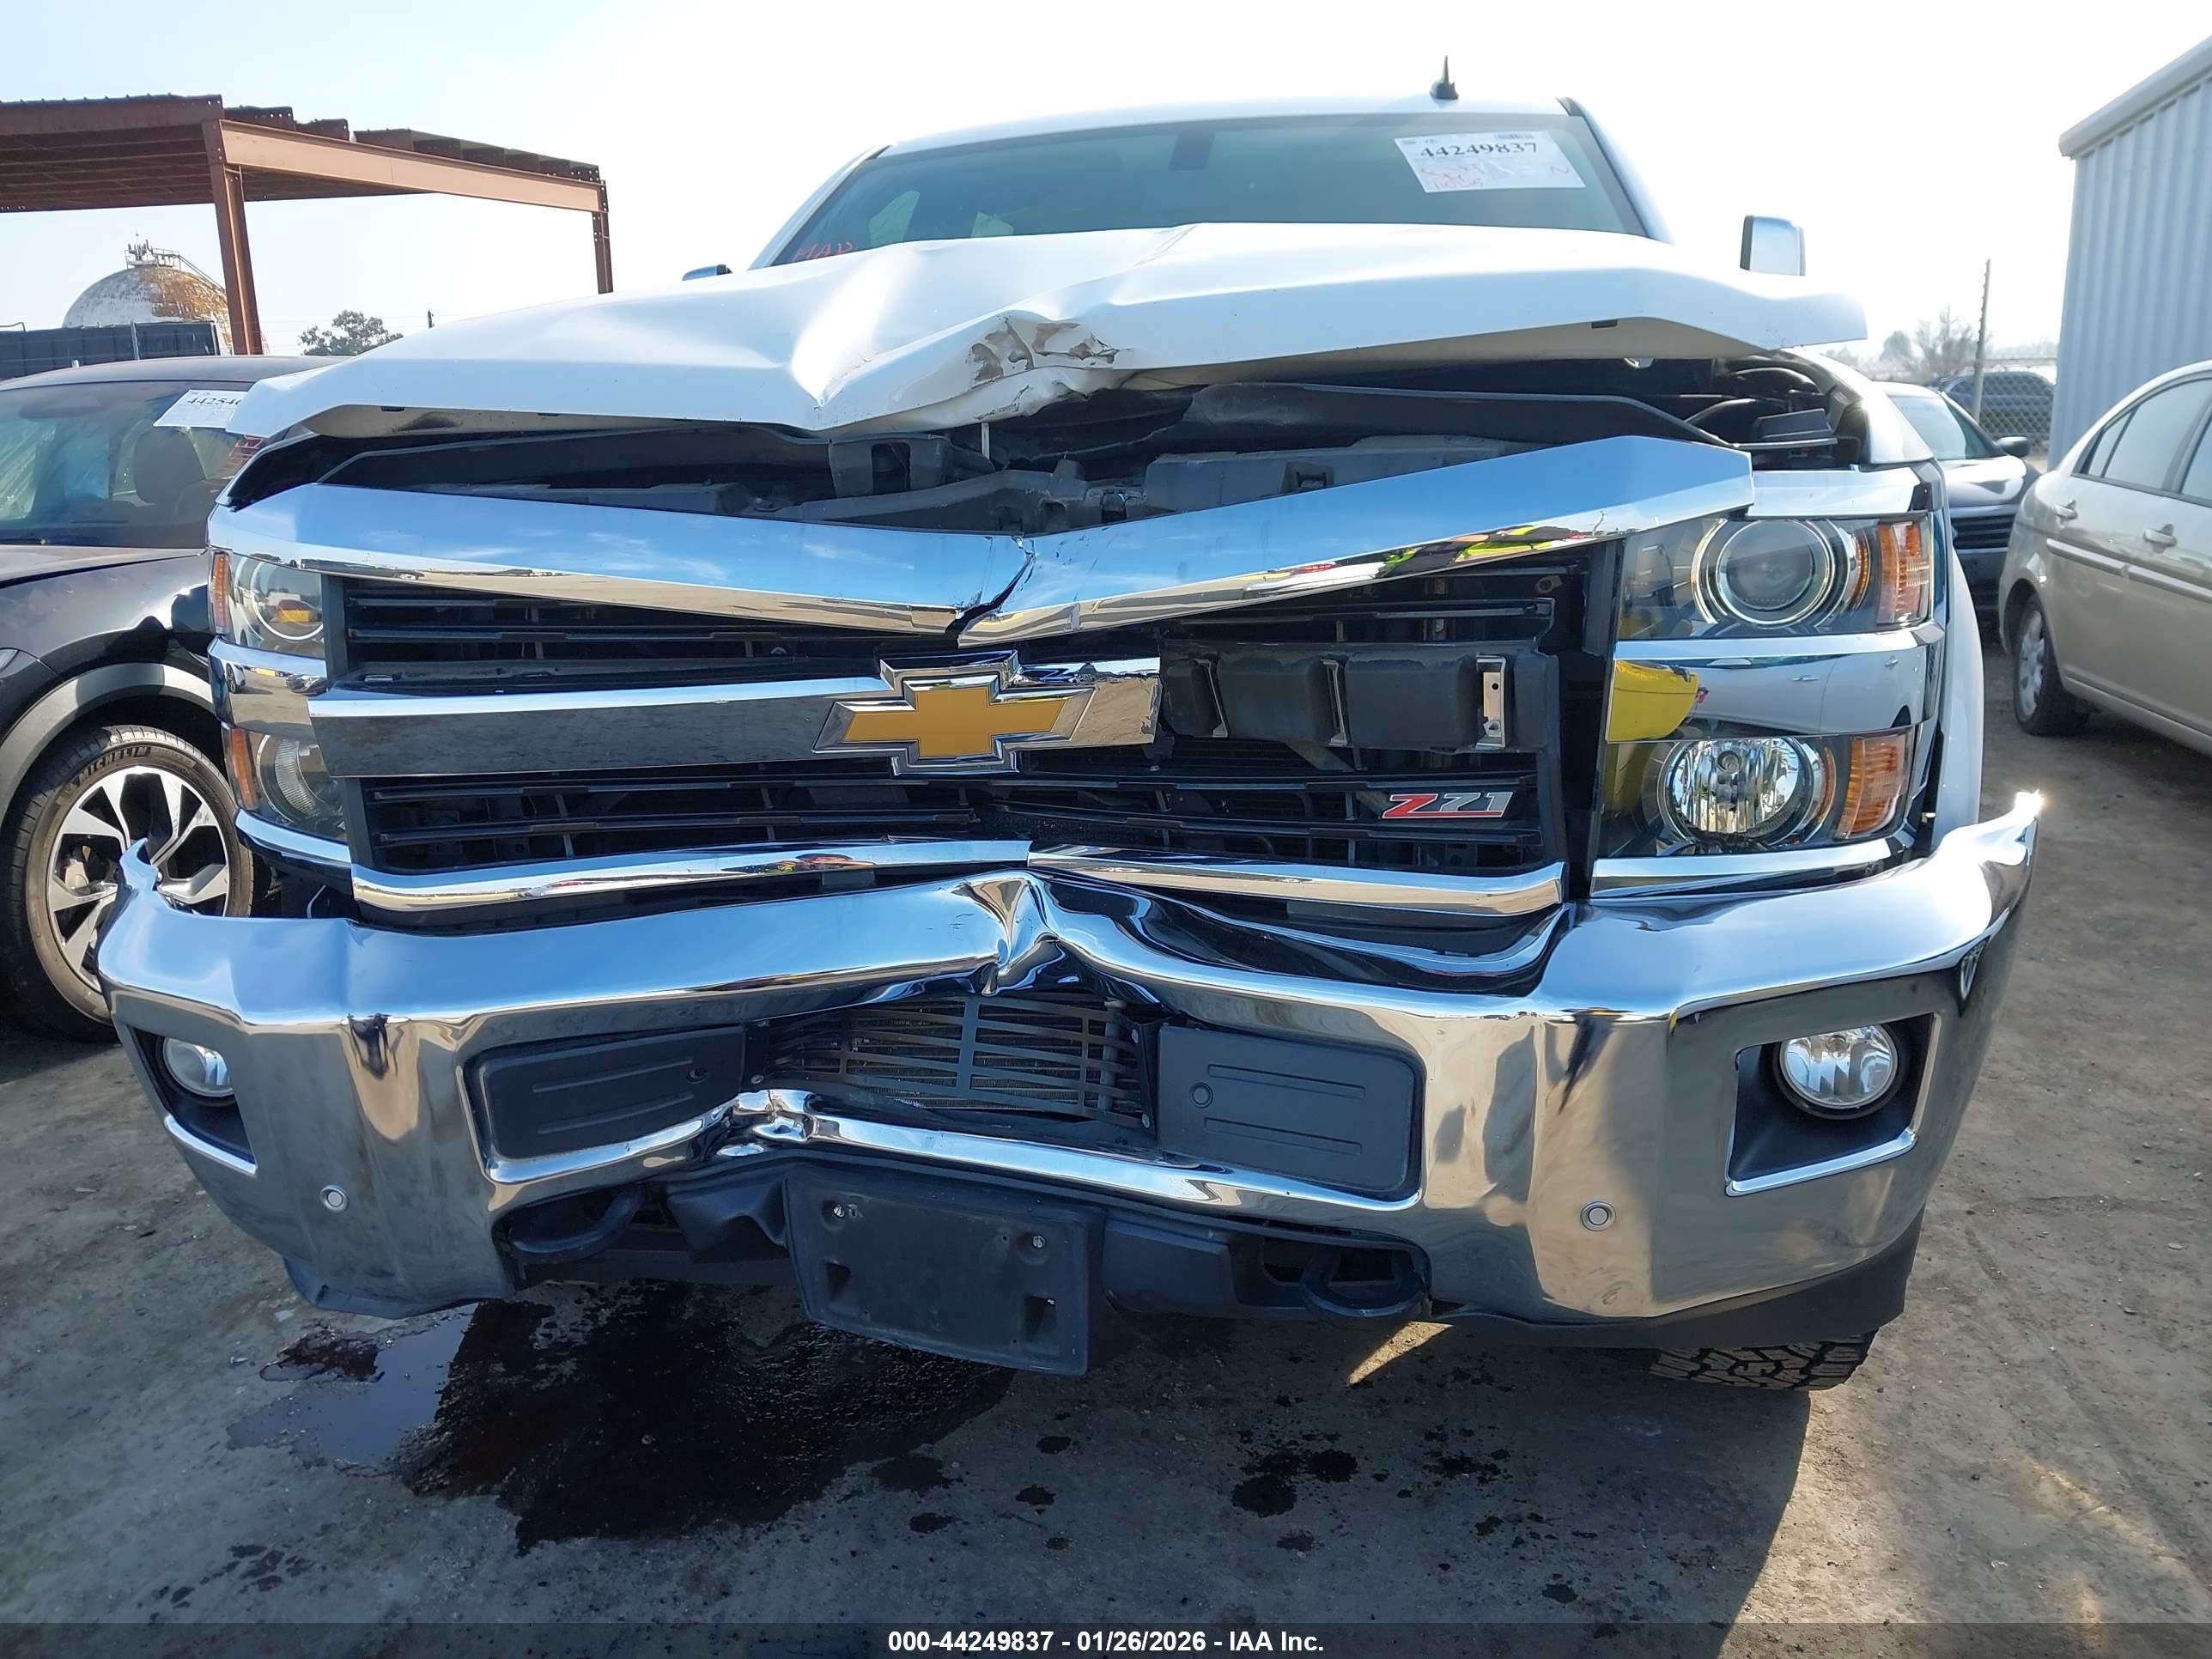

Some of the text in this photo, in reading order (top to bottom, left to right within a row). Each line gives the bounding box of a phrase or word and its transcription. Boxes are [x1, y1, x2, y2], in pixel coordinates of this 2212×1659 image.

[1420, 142, 1537, 158] 44249837
[78, 745, 149, 786] MICHELIN
[1382, 792, 1514, 819] Z71
